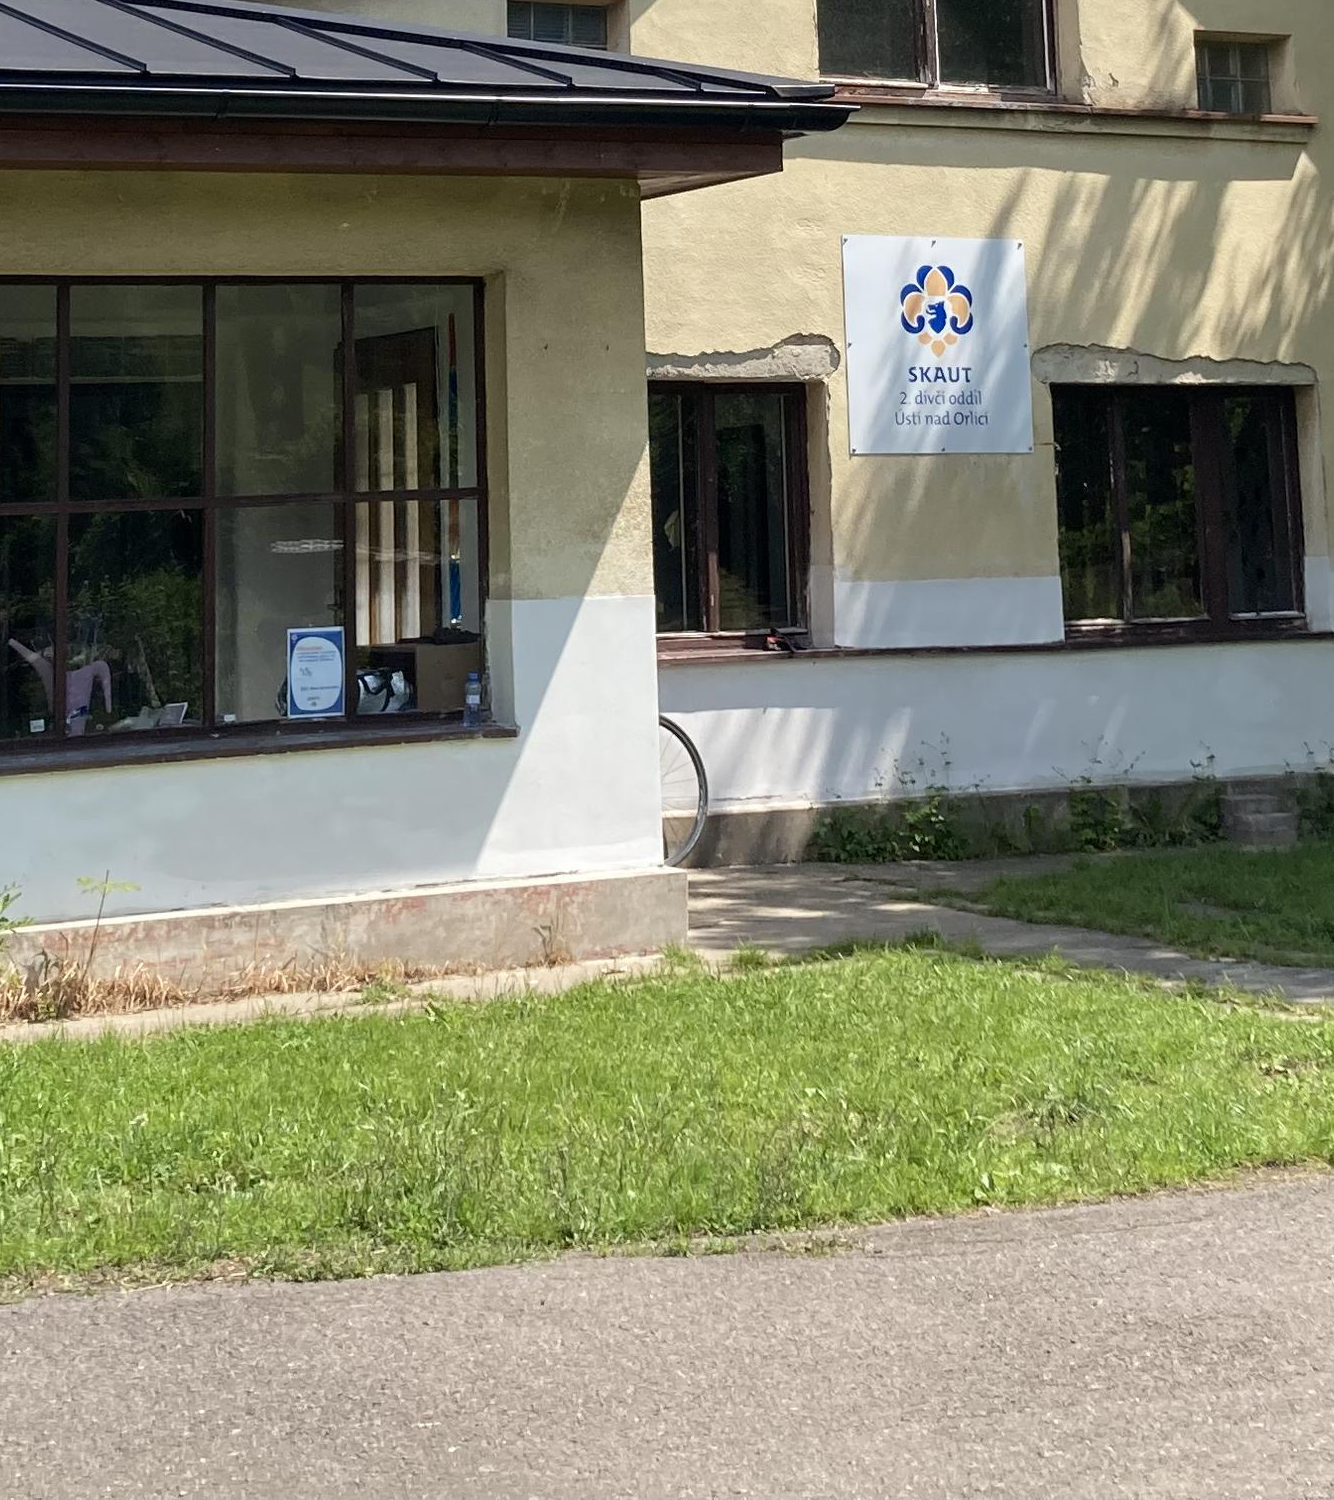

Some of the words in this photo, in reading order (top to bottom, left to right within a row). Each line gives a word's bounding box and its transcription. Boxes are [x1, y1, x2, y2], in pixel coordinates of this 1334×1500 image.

[908, 366, 972, 383] SKAUT
[899, 391, 911, 405] 2.
[894, 408, 921, 426] Ústí
[924, 410, 951, 426] nad
[953, 409, 989, 426] Orlicí
